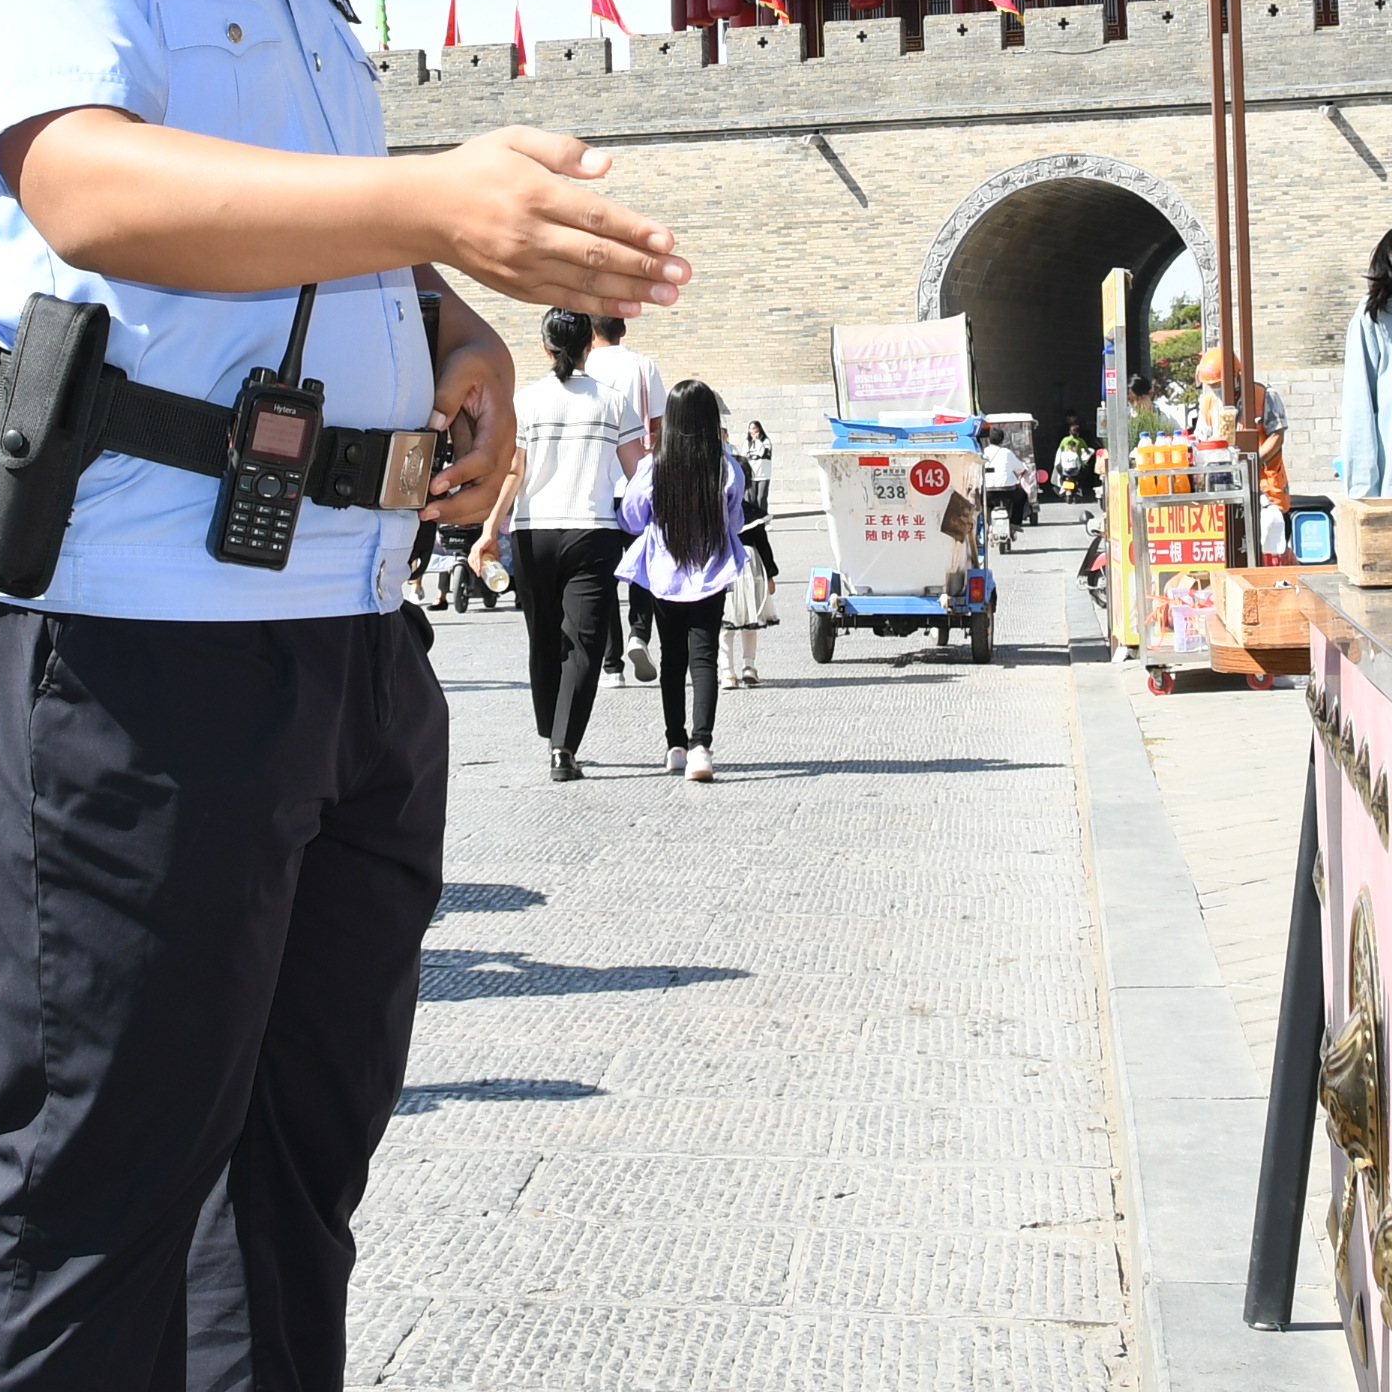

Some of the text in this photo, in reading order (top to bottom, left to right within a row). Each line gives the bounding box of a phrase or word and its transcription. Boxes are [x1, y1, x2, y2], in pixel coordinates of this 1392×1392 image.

[273, 403, 297, 415] Hytera
[915, 468, 945, 488] 143
[876, 485, 905, 500] 238
[864, 514, 926, 526] 正在作业
[865, 529, 926, 542] 随时停车
